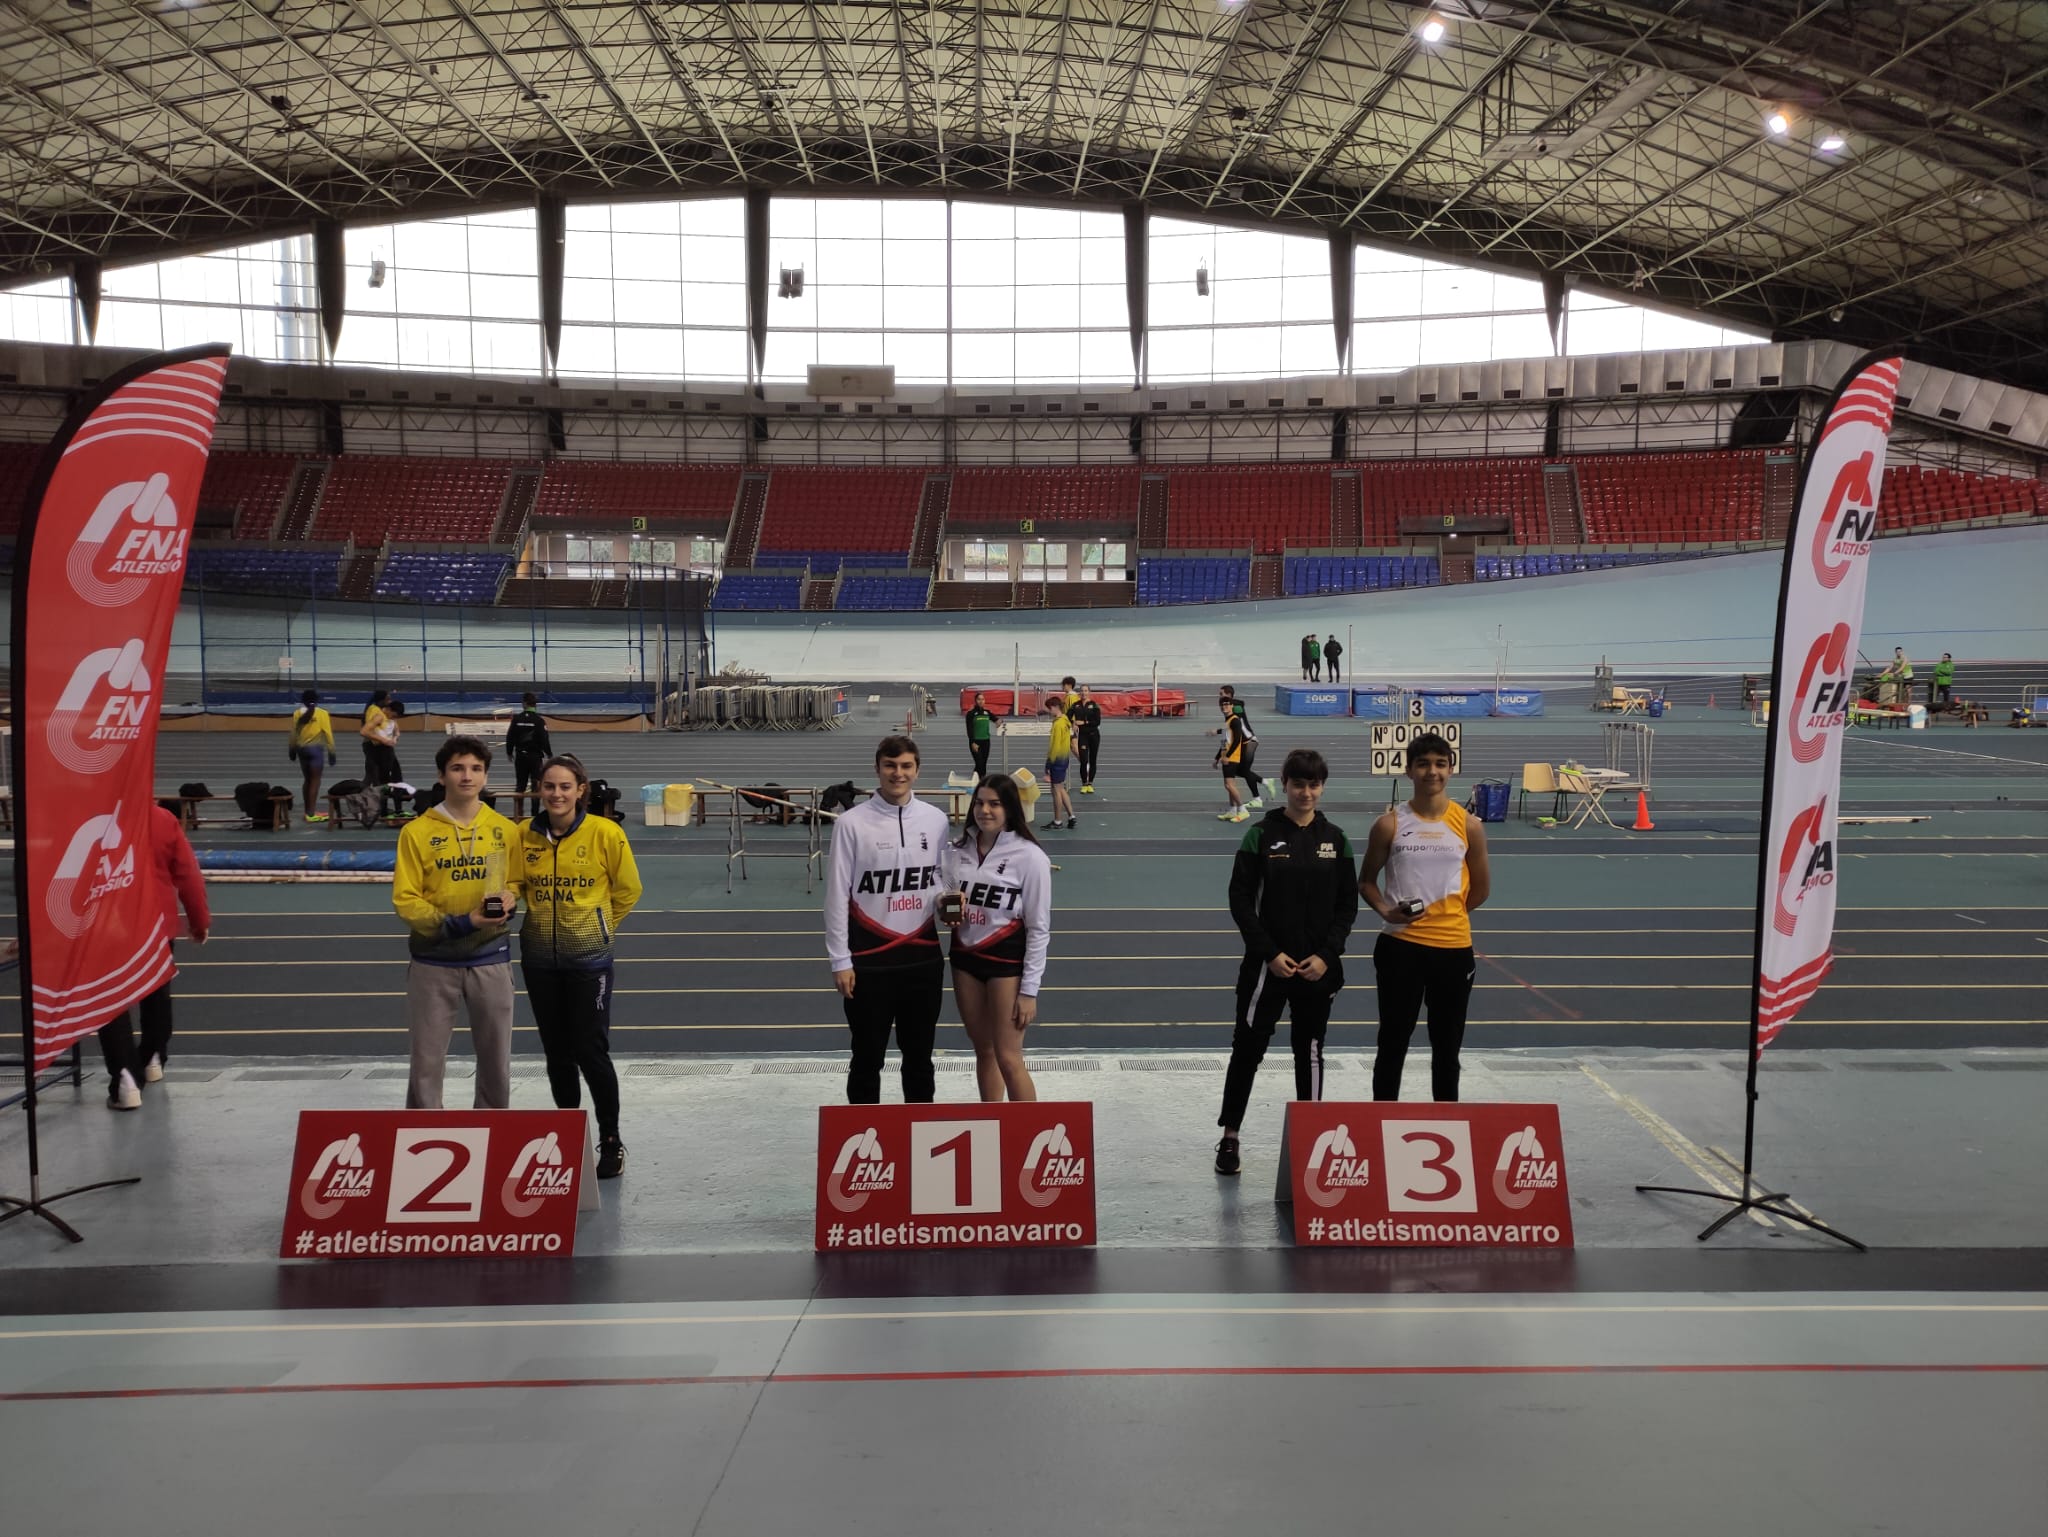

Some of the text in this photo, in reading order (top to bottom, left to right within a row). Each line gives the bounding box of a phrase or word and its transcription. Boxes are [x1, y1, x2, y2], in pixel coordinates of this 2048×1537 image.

[116, 528, 187, 560] FNA
[107, 560, 182, 574] ATLETISO
[1411, 700, 1422, 717] 3
[886, 894, 923, 912] Tudela
[399, 1139, 473, 1212] 2
[852, 1162, 896, 1182] FNA
[930, 1130, 972, 1207] 1
[1042, 1157, 1085, 1177] FNA
[1327, 1158, 1369, 1178] FNA
[1401, 1131, 1462, 1202] 3
[1515, 1160, 1558, 1179] FNA
[327, 1168, 375, 1188] FNA
[526, 1167, 574, 1187] FNA
[848, 1181, 894, 1191] ATLETISMO
[1039, 1176, 1084, 1186] ATLETISMO
[1324, 1177, 1369, 1187] ATLETISMO
[1513, 1178, 1558, 1188] ATLETISMO
[322, 1187, 371, 1198] ATLETISMO
[522, 1186, 571, 1196] ATLETISMO
[826, 1221, 1083, 1247] #atletismonavarro
[1308, 1217, 1560, 1243] #atletismonavarro
[295, 1229, 562, 1255] #atletismonavarro
